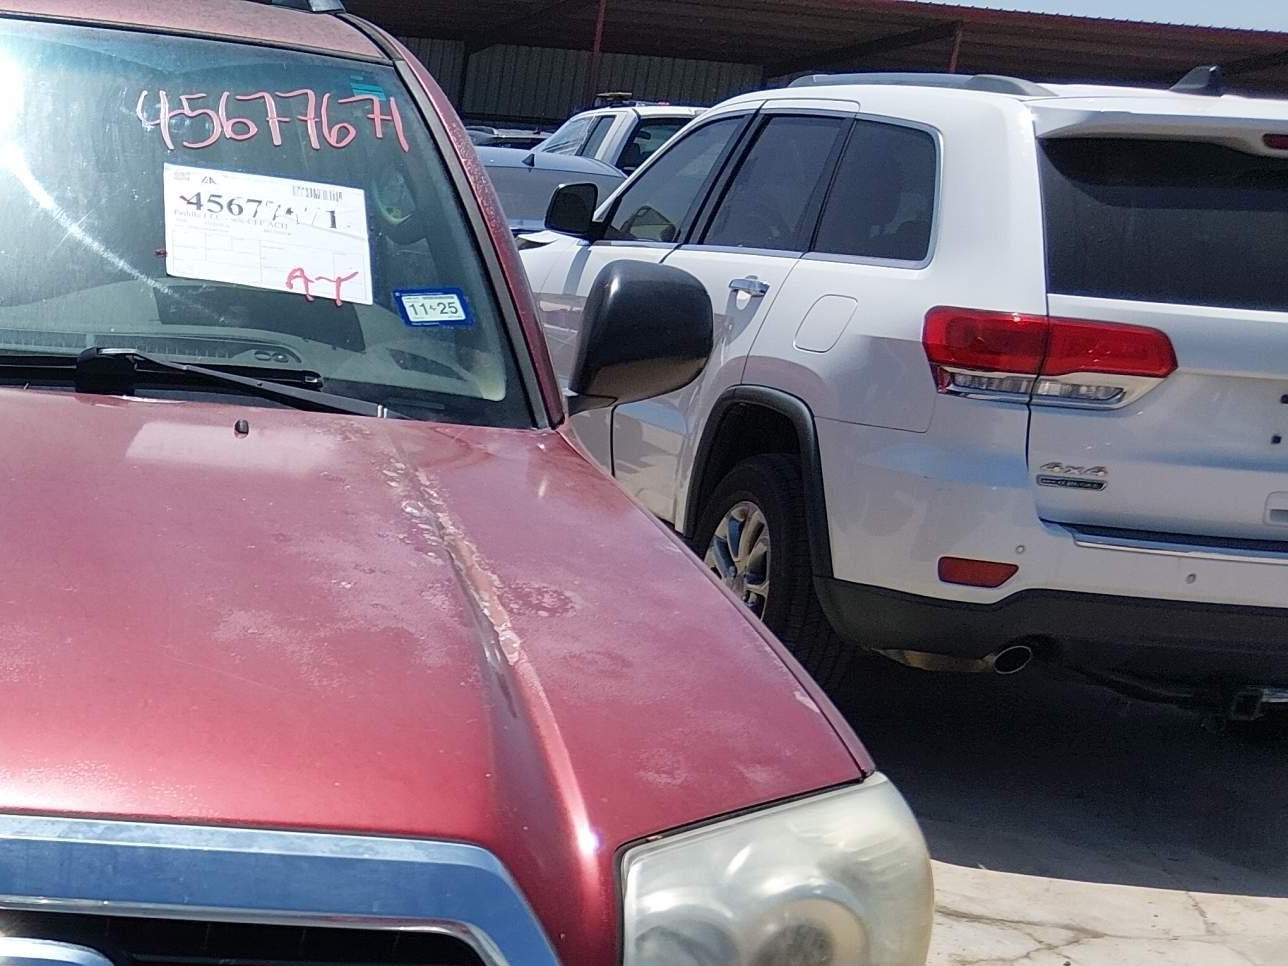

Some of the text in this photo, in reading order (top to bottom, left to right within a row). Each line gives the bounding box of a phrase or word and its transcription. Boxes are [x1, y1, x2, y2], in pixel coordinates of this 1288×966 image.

[135, 88, 409, 153] 45677671
[409, 302, 459, 316] 11 25
